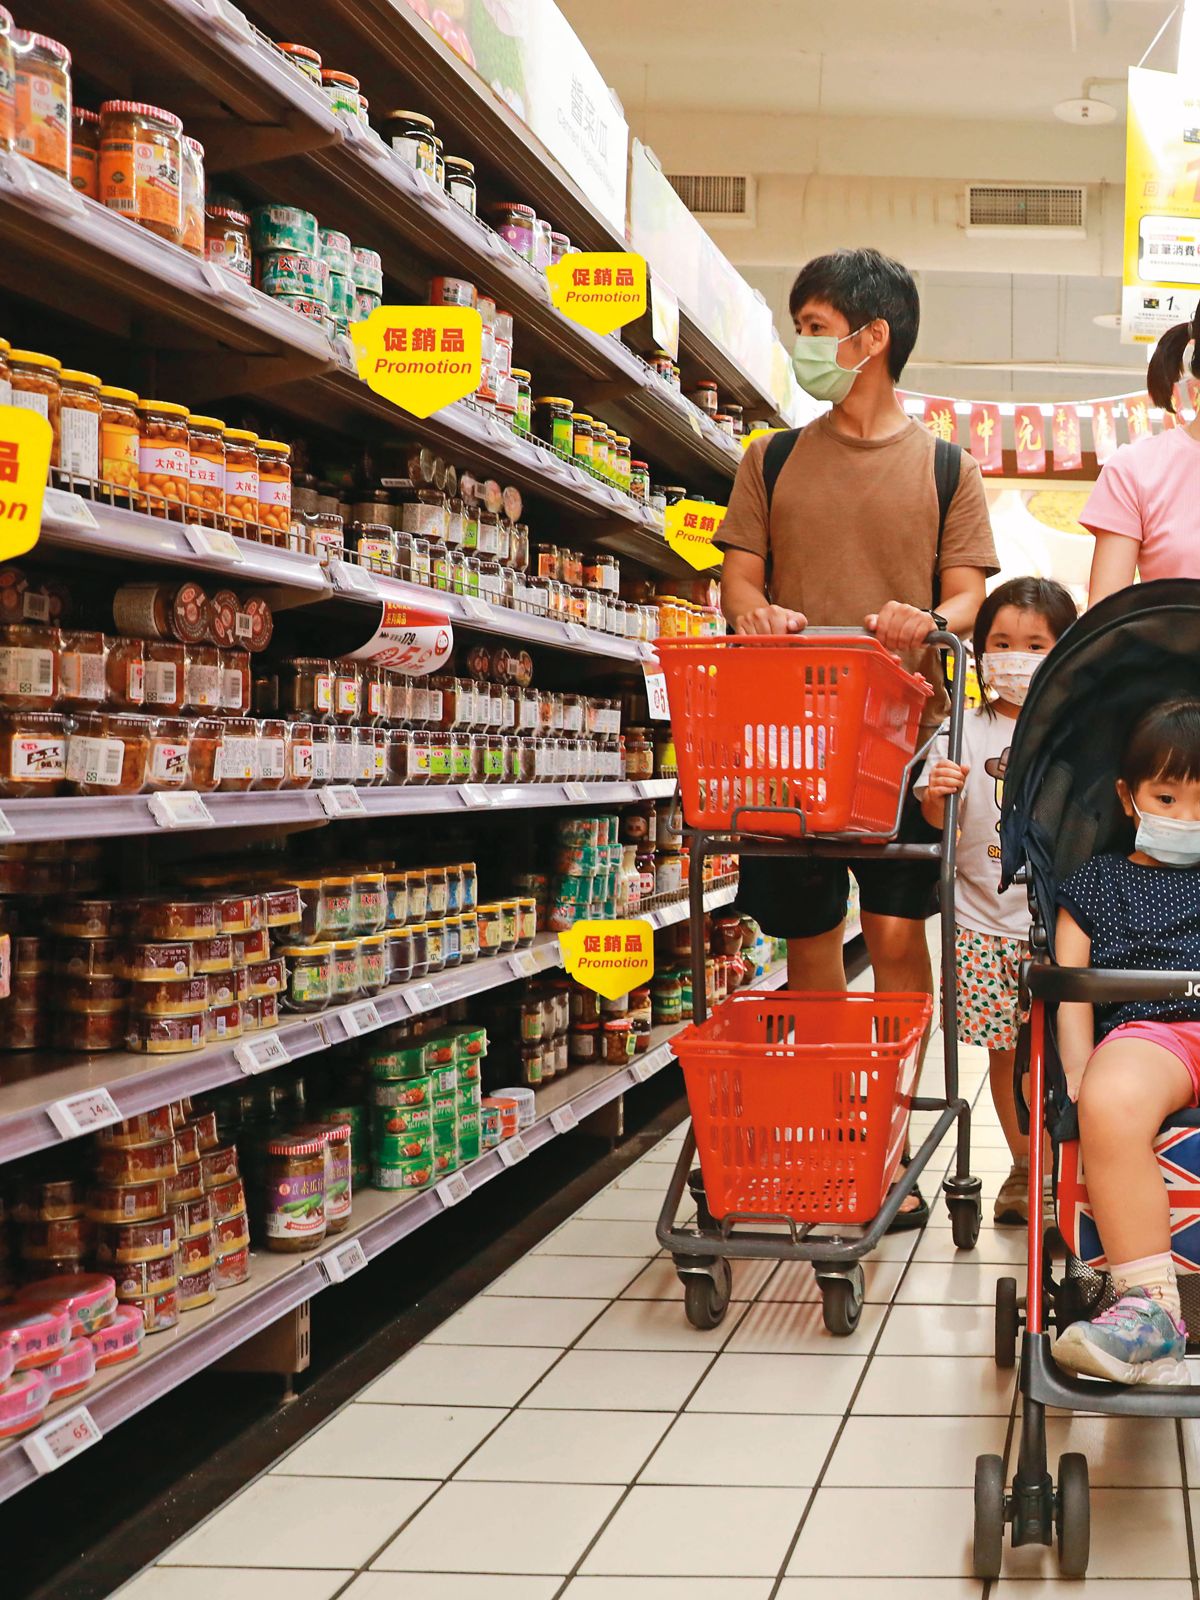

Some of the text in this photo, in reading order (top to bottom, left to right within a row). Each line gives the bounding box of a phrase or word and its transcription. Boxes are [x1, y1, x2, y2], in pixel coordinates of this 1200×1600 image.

[572, 268, 635, 287] 促銷品
[566, 291, 641, 303] Promotion
[383, 327, 465, 352] 促銷品
[374, 357, 473, 374] Promotion
[977, 408, 995, 457] 中
[1018, 415, 1042, 453] 元
[684, 512, 725, 532] 促銷
[583, 934, 643, 953] 促銷品
[577, 956, 648, 970] Promotion
[73, 1423, 88, 1439] 65
